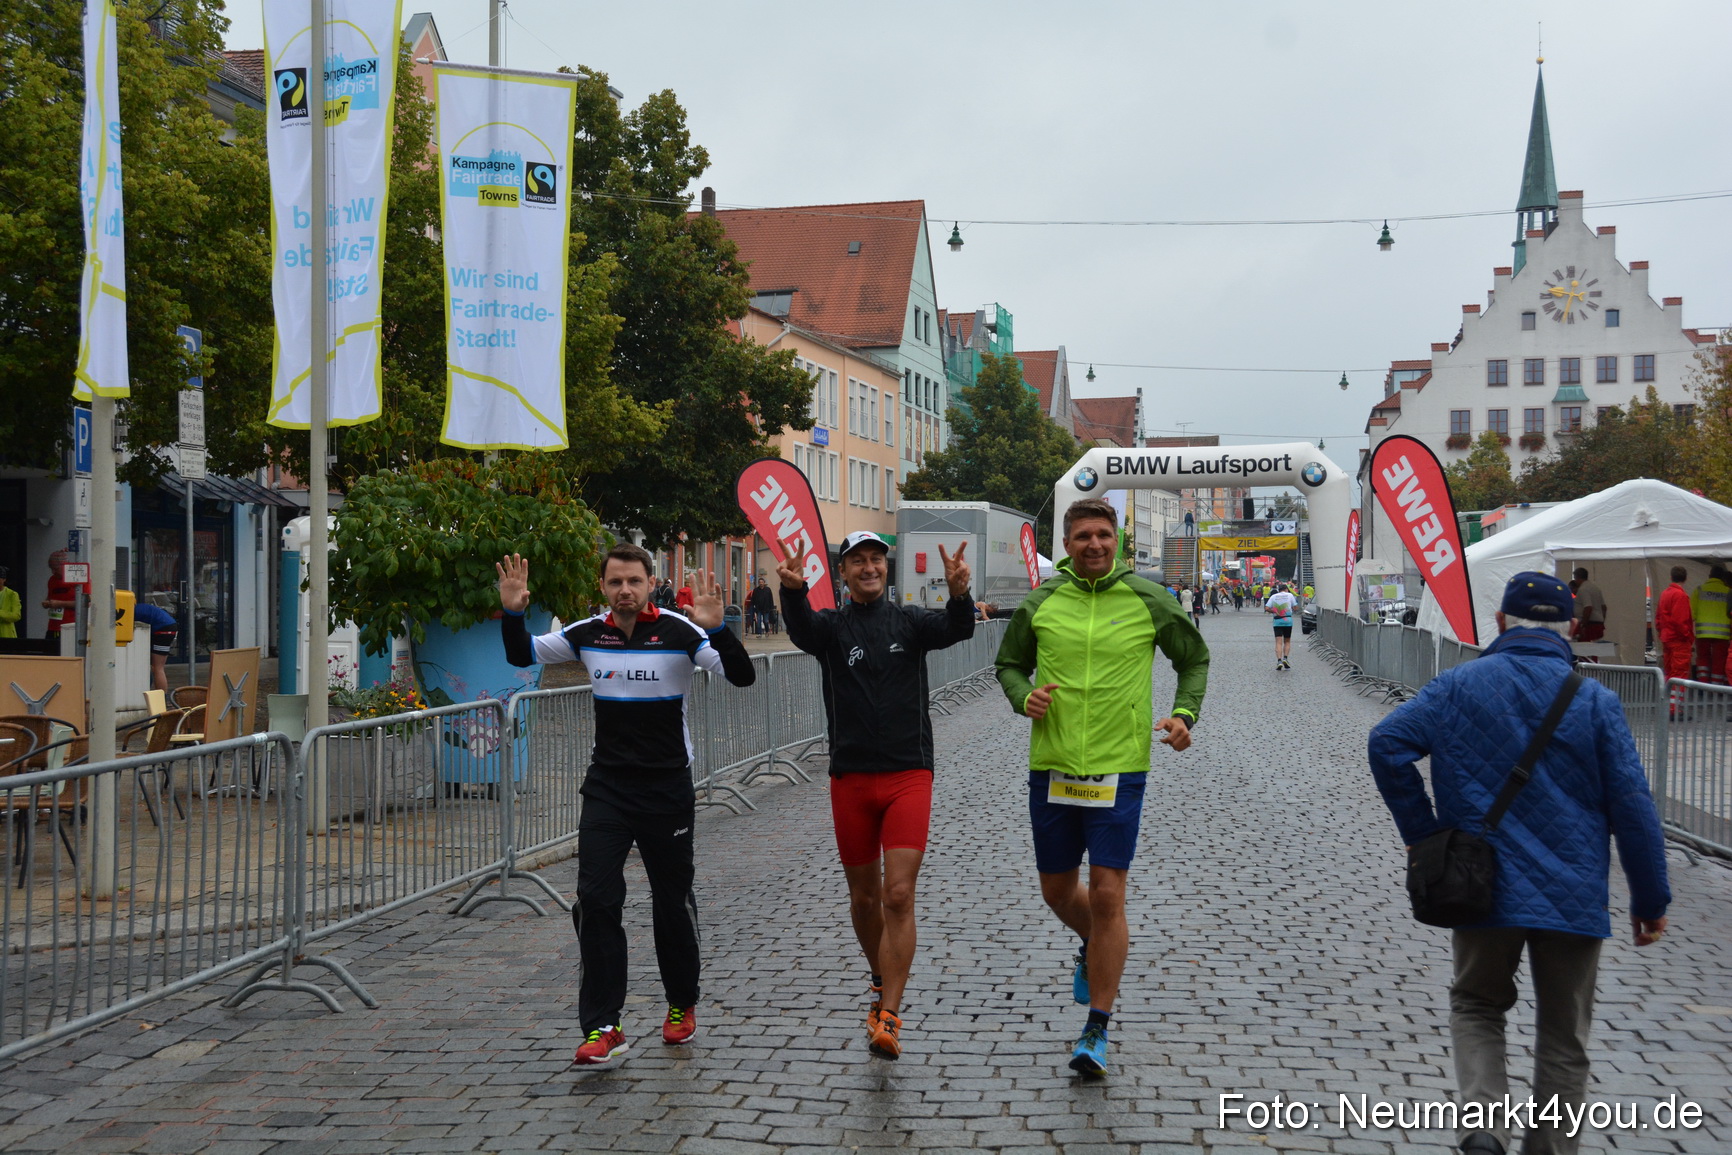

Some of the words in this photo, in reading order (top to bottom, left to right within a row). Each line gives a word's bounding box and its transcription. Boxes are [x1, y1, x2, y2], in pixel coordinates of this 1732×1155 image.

[452, 157, 516, 171] Kampagne
[452, 169, 521, 186] Fairtrade
[480, 189, 518, 202] Towns
[526, 195, 555, 203] FAIRTRADE
[450, 267, 488, 288] Wir
[494, 269, 538, 291] sind
[451, 297, 554, 322] Fairtrade-
[455, 327, 516, 348] Stadt!
[79, 417, 89, 464] P
[1106, 456, 1171, 475] BMW
[1177, 453, 1293, 477] Laufsport
[1237, 539, 1260, 548] ZIEL
[1347, 518, 1358, 577] REWE
[627, 670, 660, 681] LELL
[1065, 786, 1100, 798] Maurice
